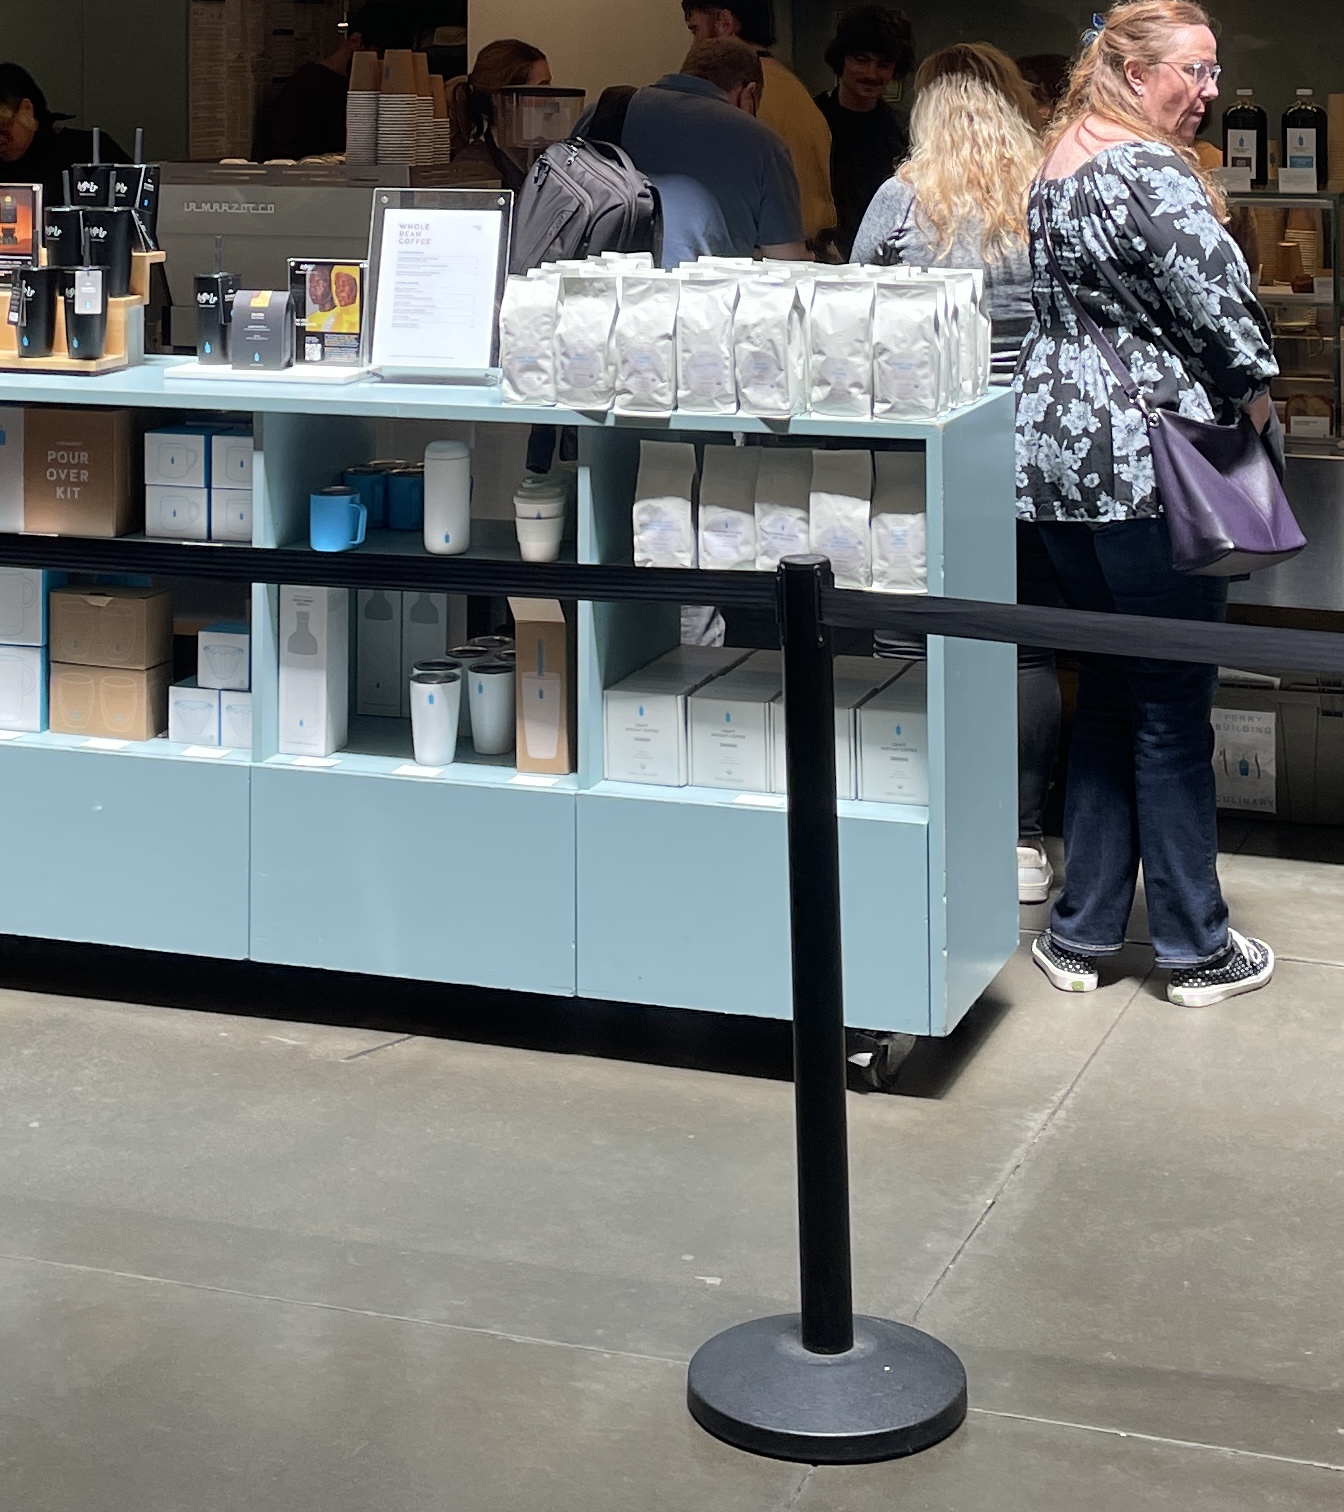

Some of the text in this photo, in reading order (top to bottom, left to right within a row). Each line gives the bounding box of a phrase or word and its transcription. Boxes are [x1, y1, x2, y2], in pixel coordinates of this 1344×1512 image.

[202, 202, 275, 213] MARZOCCO
[399, 223, 430, 231] WHOLE
[47, 451, 89, 464] POUR
[46, 468, 89, 482] OVER
[56, 486, 80, 499] KIT
[1224, 713, 1262, 723] FERRY
[1216, 723, 1272, 734] BUILDING
